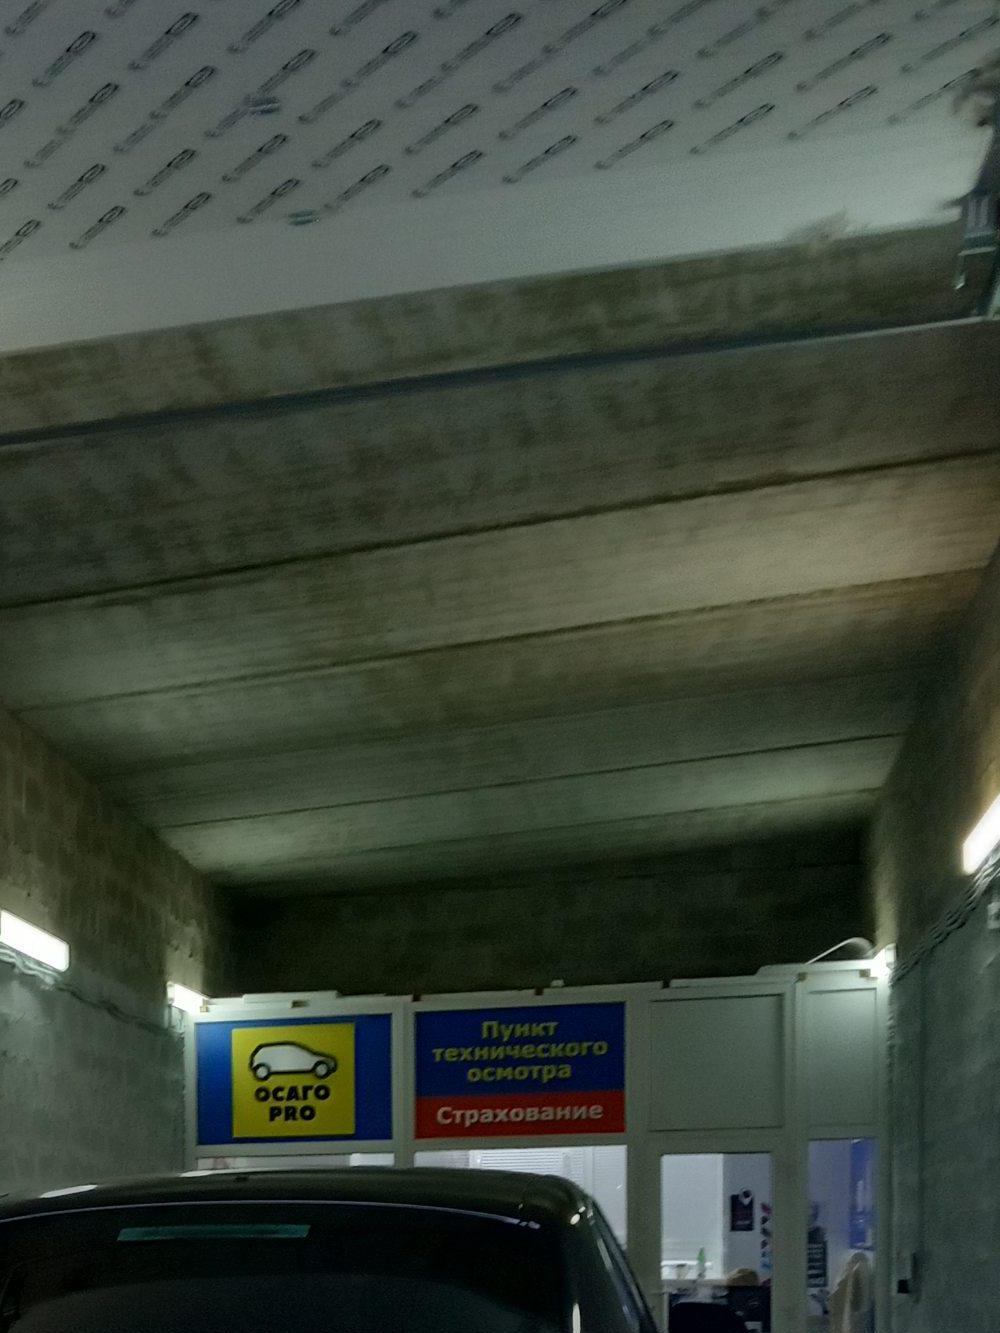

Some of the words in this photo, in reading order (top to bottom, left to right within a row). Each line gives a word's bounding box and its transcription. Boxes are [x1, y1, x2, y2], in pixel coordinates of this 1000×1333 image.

[481, 1020, 559, 1041] Пункт
[432, 1041, 609, 1063] технического
[467, 1063, 572, 1083] осмотра
[254, 1084, 331, 1102] ОСАГО
[269, 1105, 316, 1122] PRO
[436, 1104, 605, 1128] Страхование
